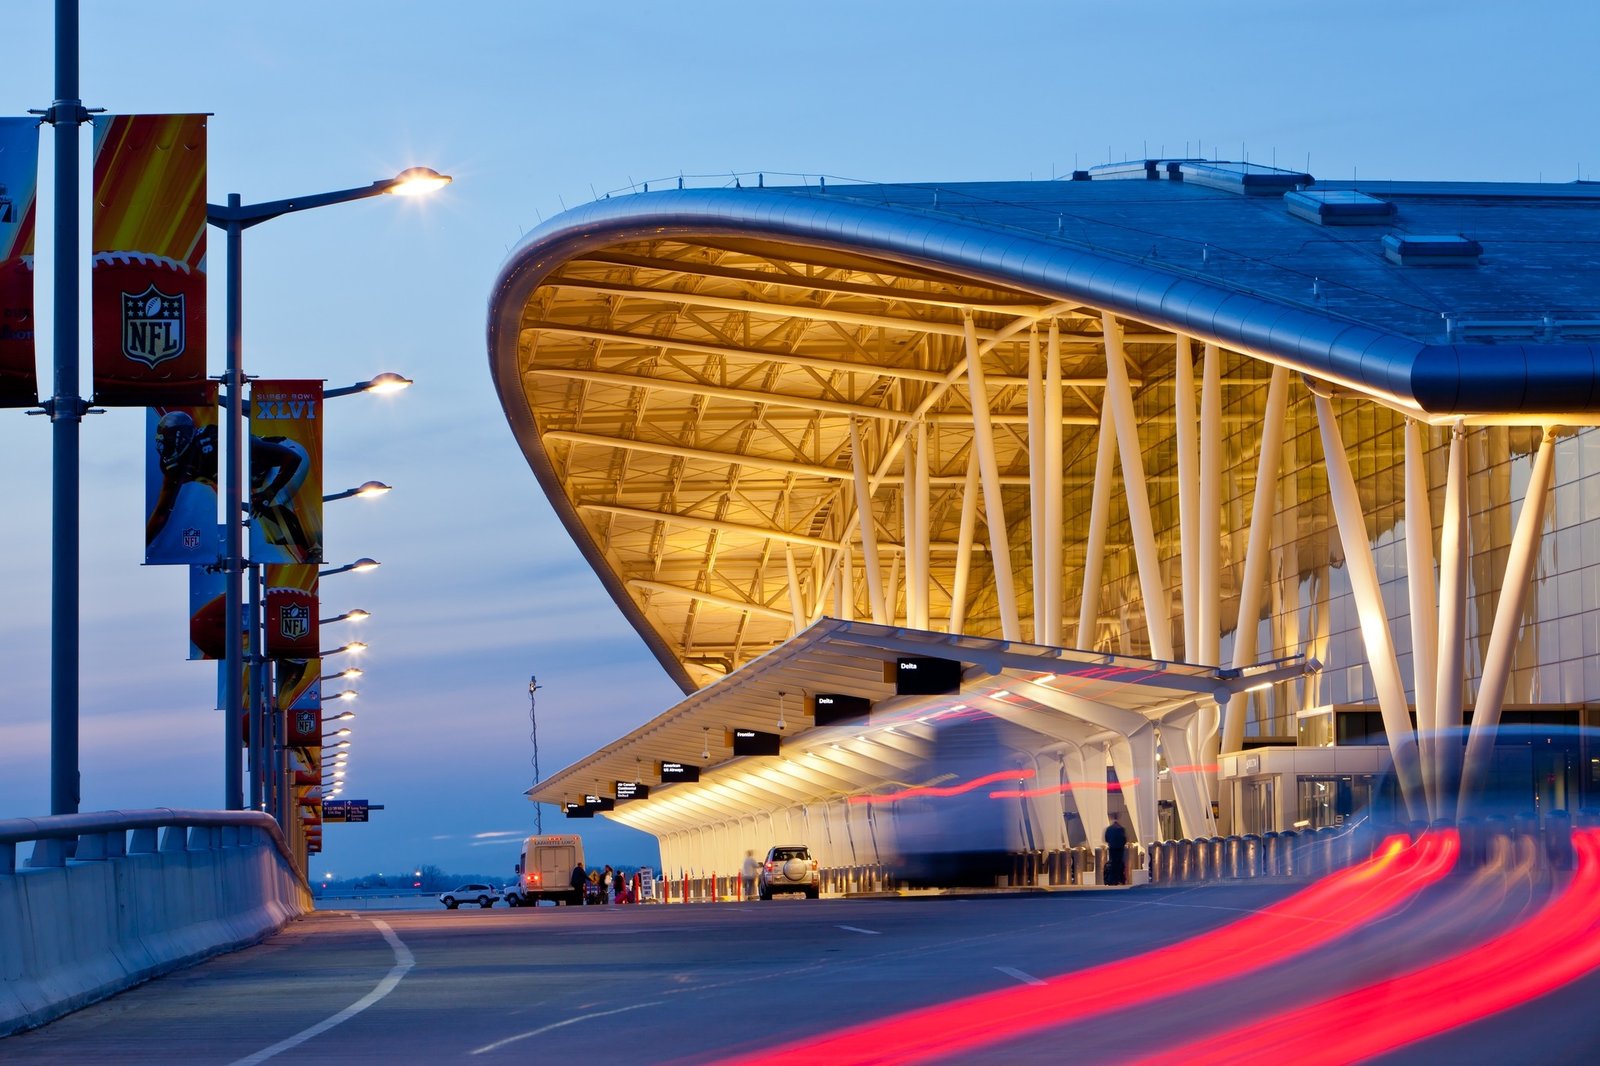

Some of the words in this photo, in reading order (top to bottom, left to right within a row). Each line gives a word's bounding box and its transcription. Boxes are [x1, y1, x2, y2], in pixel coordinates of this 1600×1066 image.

[130, 321, 178, 357] NFL
[257, 401, 316, 419] XLVI
[184, 536, 200, 548] NFL
[284, 619, 307, 635] NFL
[900, 662, 918, 670] Delta
[298, 720, 314, 732] NFL
